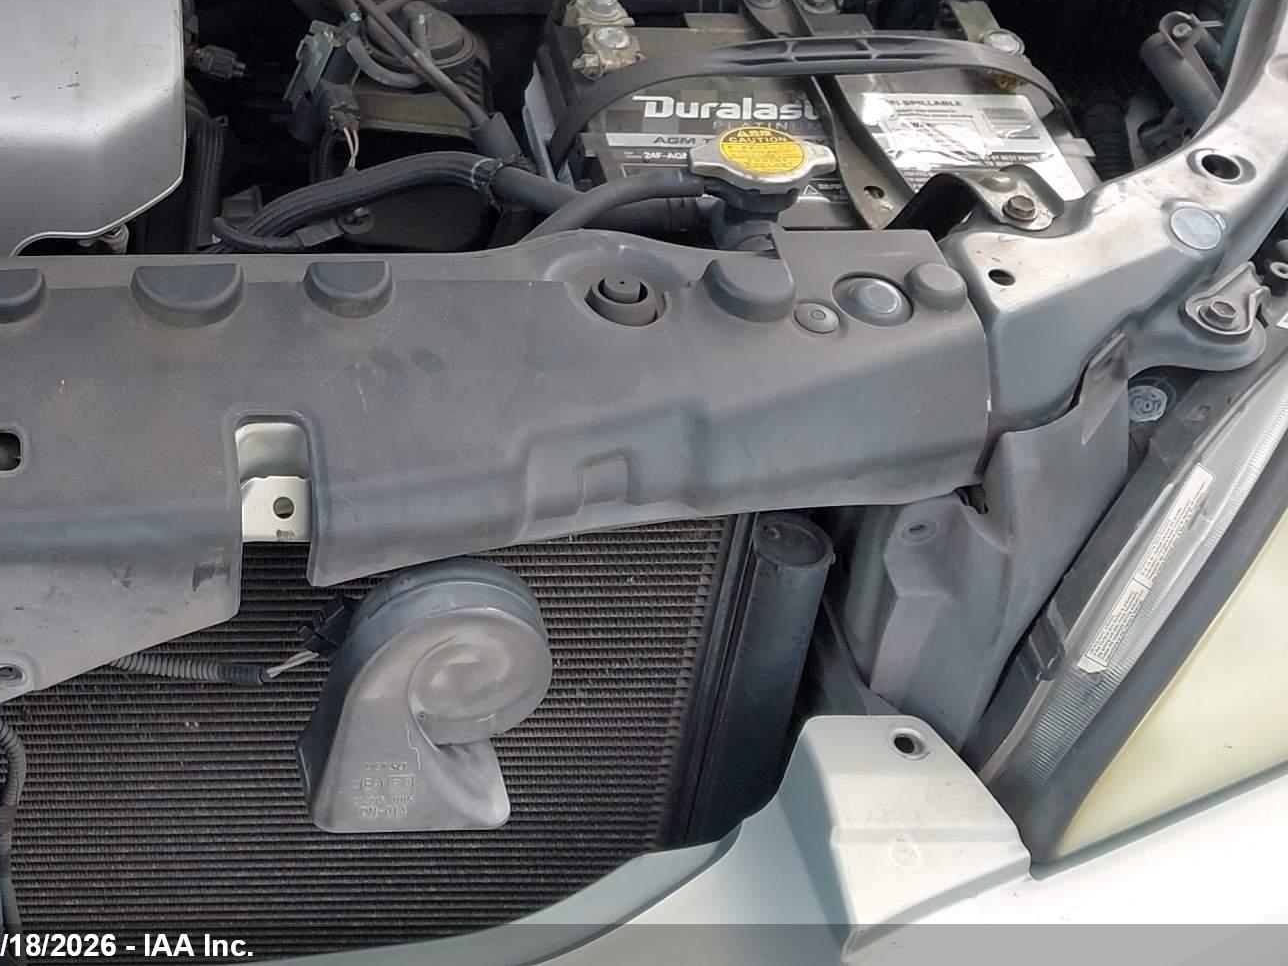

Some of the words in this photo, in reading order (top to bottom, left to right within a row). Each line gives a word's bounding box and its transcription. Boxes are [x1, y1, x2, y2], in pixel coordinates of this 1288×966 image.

[630, 94, 821, 121] Duralast
[652, 136, 696, 145] AGM
[727, 136, 788, 144] CAUTION
